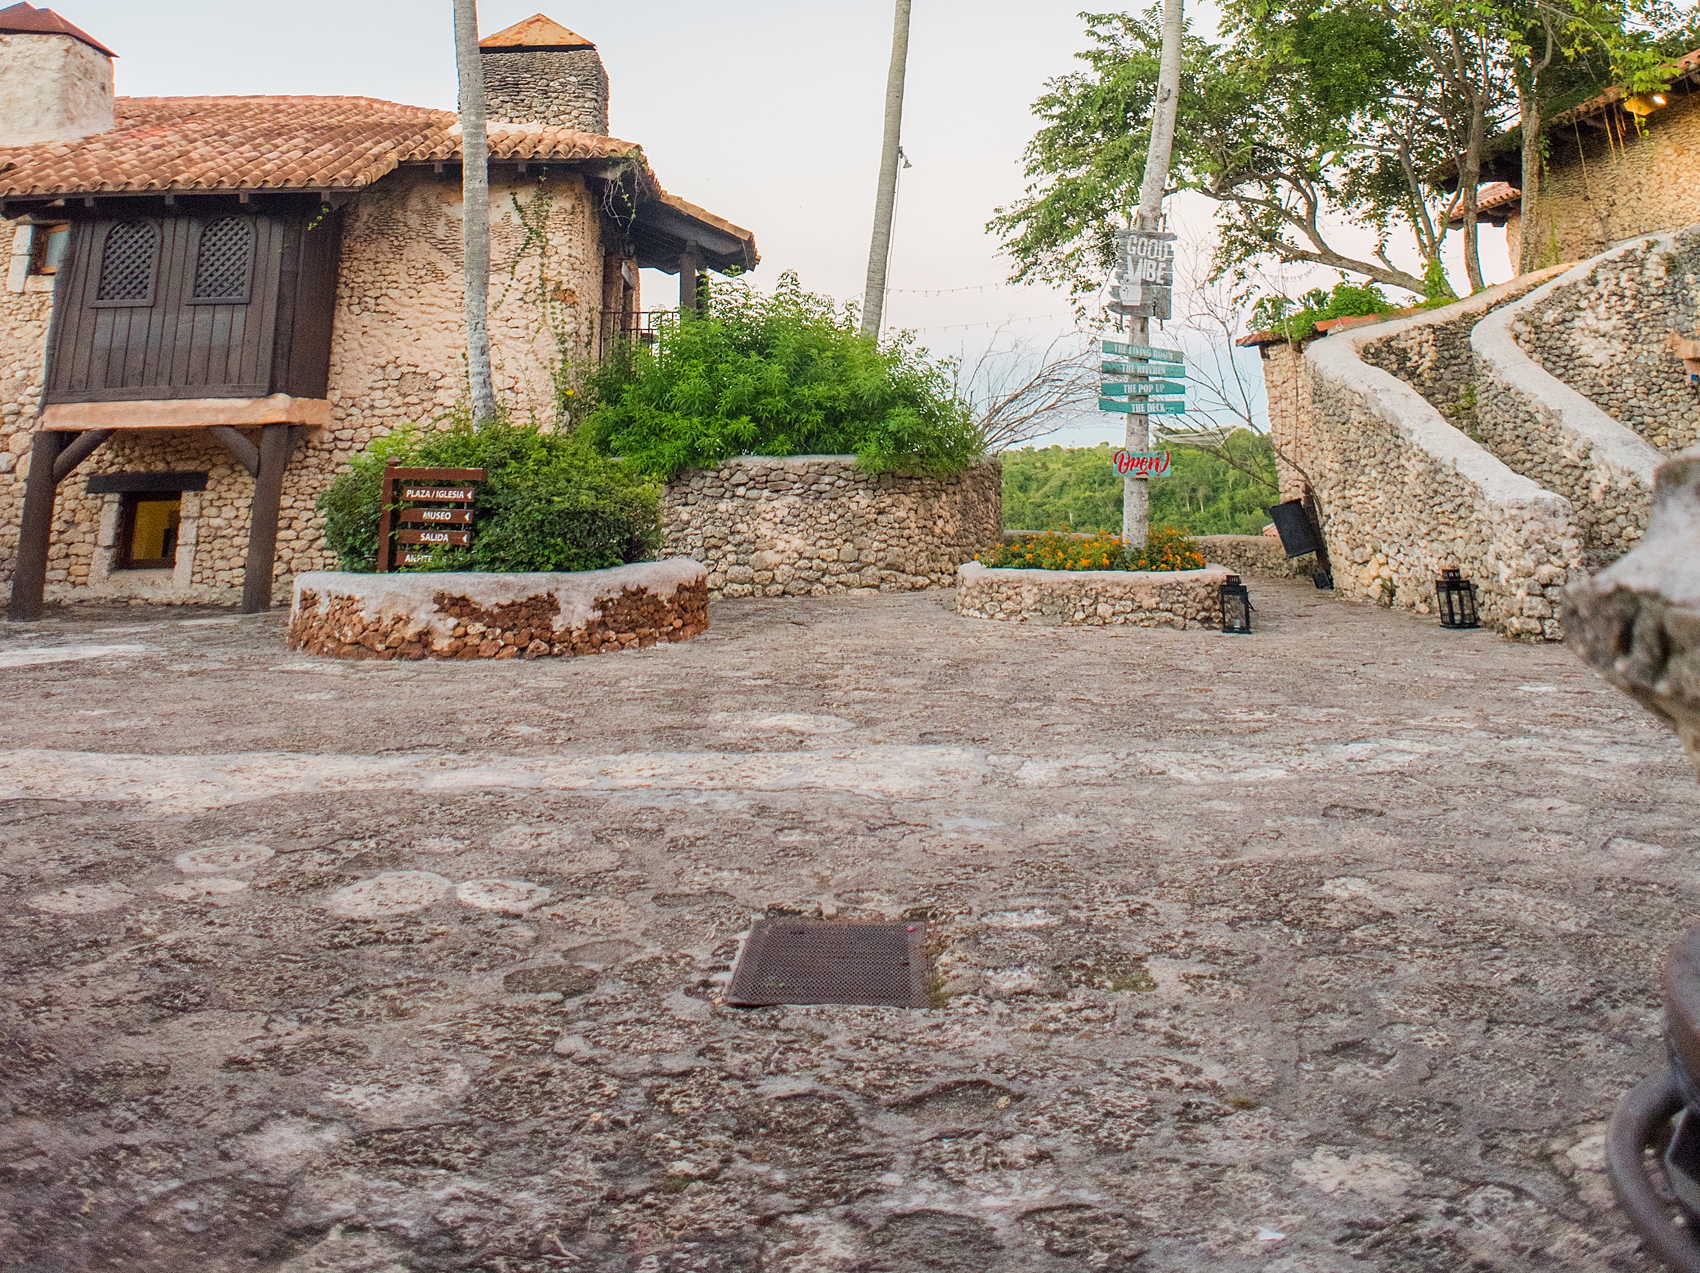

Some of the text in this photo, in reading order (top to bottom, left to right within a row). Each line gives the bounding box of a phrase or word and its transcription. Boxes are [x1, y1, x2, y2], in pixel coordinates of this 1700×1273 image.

[1127, 235, 1168, 261] GOOD
[1114, 344, 1127, 354] THE
[1128, 345, 1151, 358] LIVING
[1121, 364, 1166, 375] THE KITCHEN
[1123, 383, 1165, 393] THE POP UP
[1131, 403, 1166, 413] THE DECK
[1113, 450, 1171, 476] Open
[406, 489, 431, 498] PLAZA
[436, 490, 465, 499] IGLESIA
[423, 511, 452, 520] MUSEO
[420, 532, 449, 542] SALIDA
